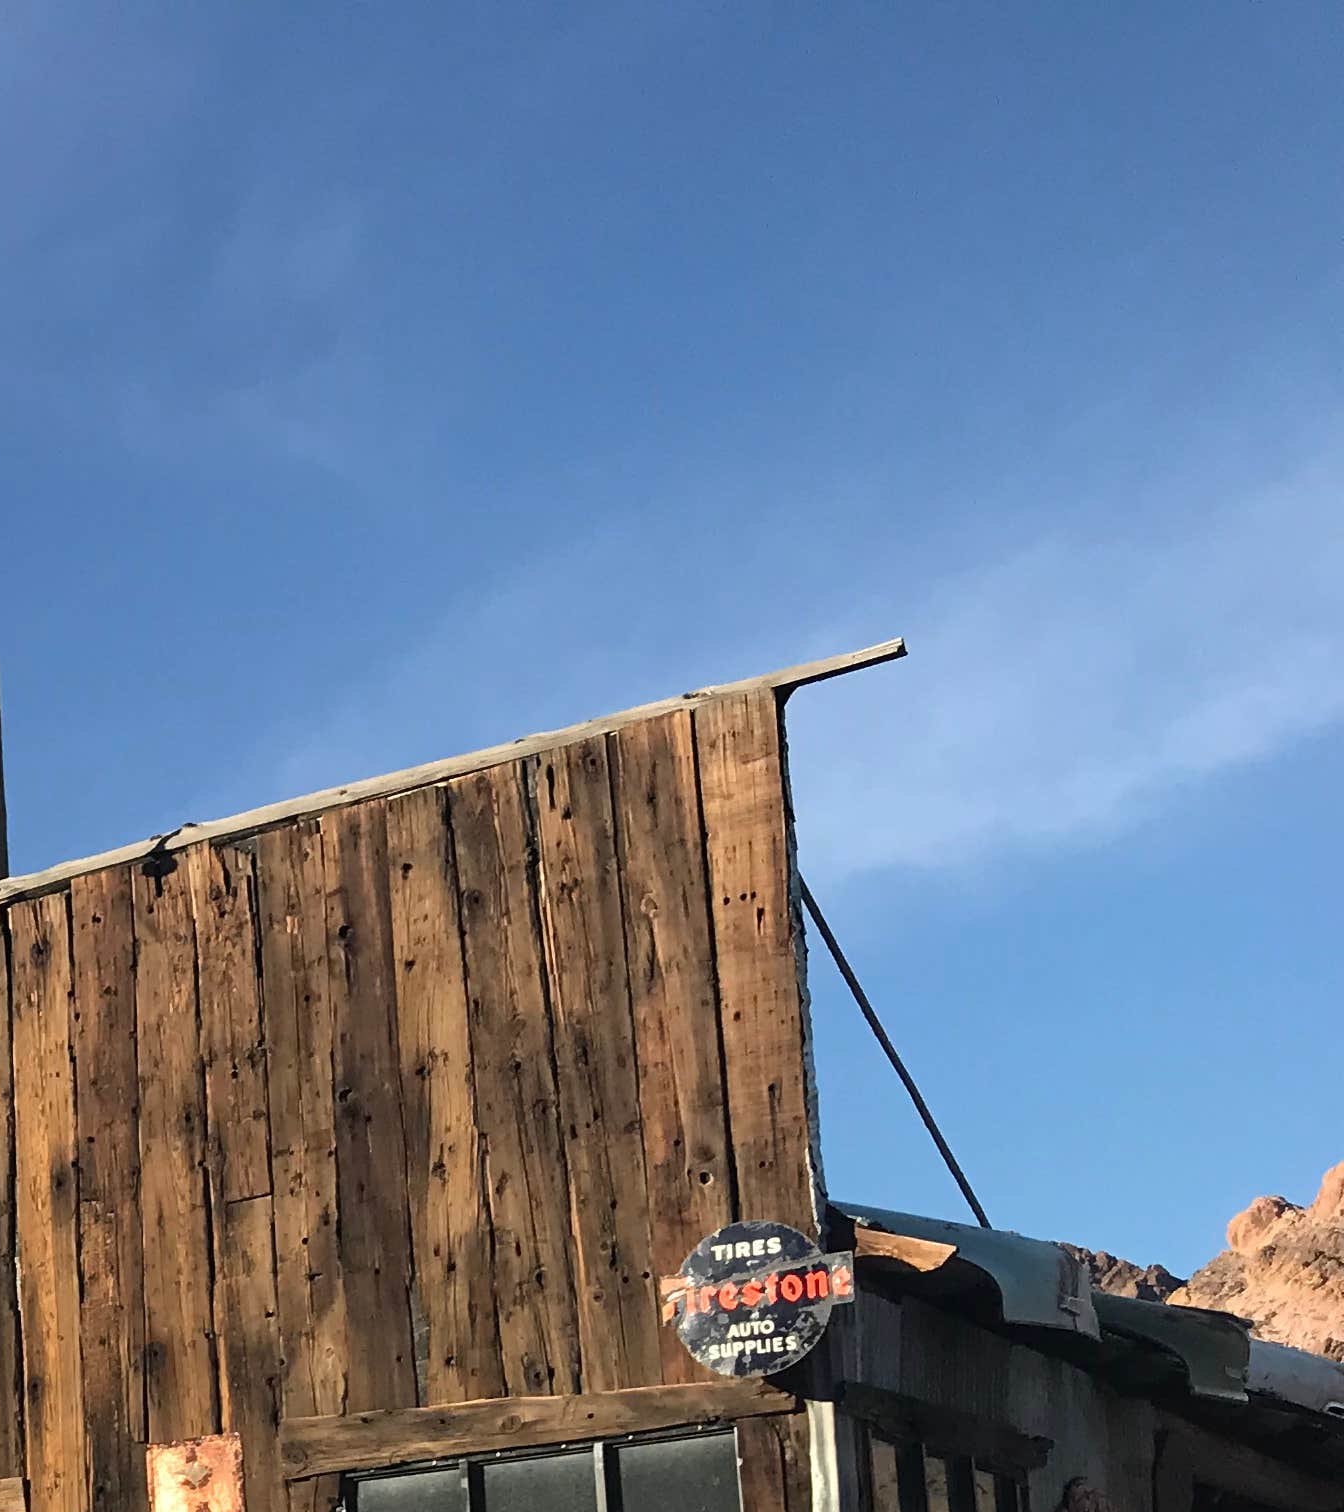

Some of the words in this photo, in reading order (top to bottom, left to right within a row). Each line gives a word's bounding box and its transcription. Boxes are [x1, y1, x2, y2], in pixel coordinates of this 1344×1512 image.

[711, 1237, 782, 1261] TIRES
[660, 1265, 853, 1324] Firestone
[727, 1319, 775, 1339] AUTO
[708, 1335, 798, 1361] SUPPLIES
